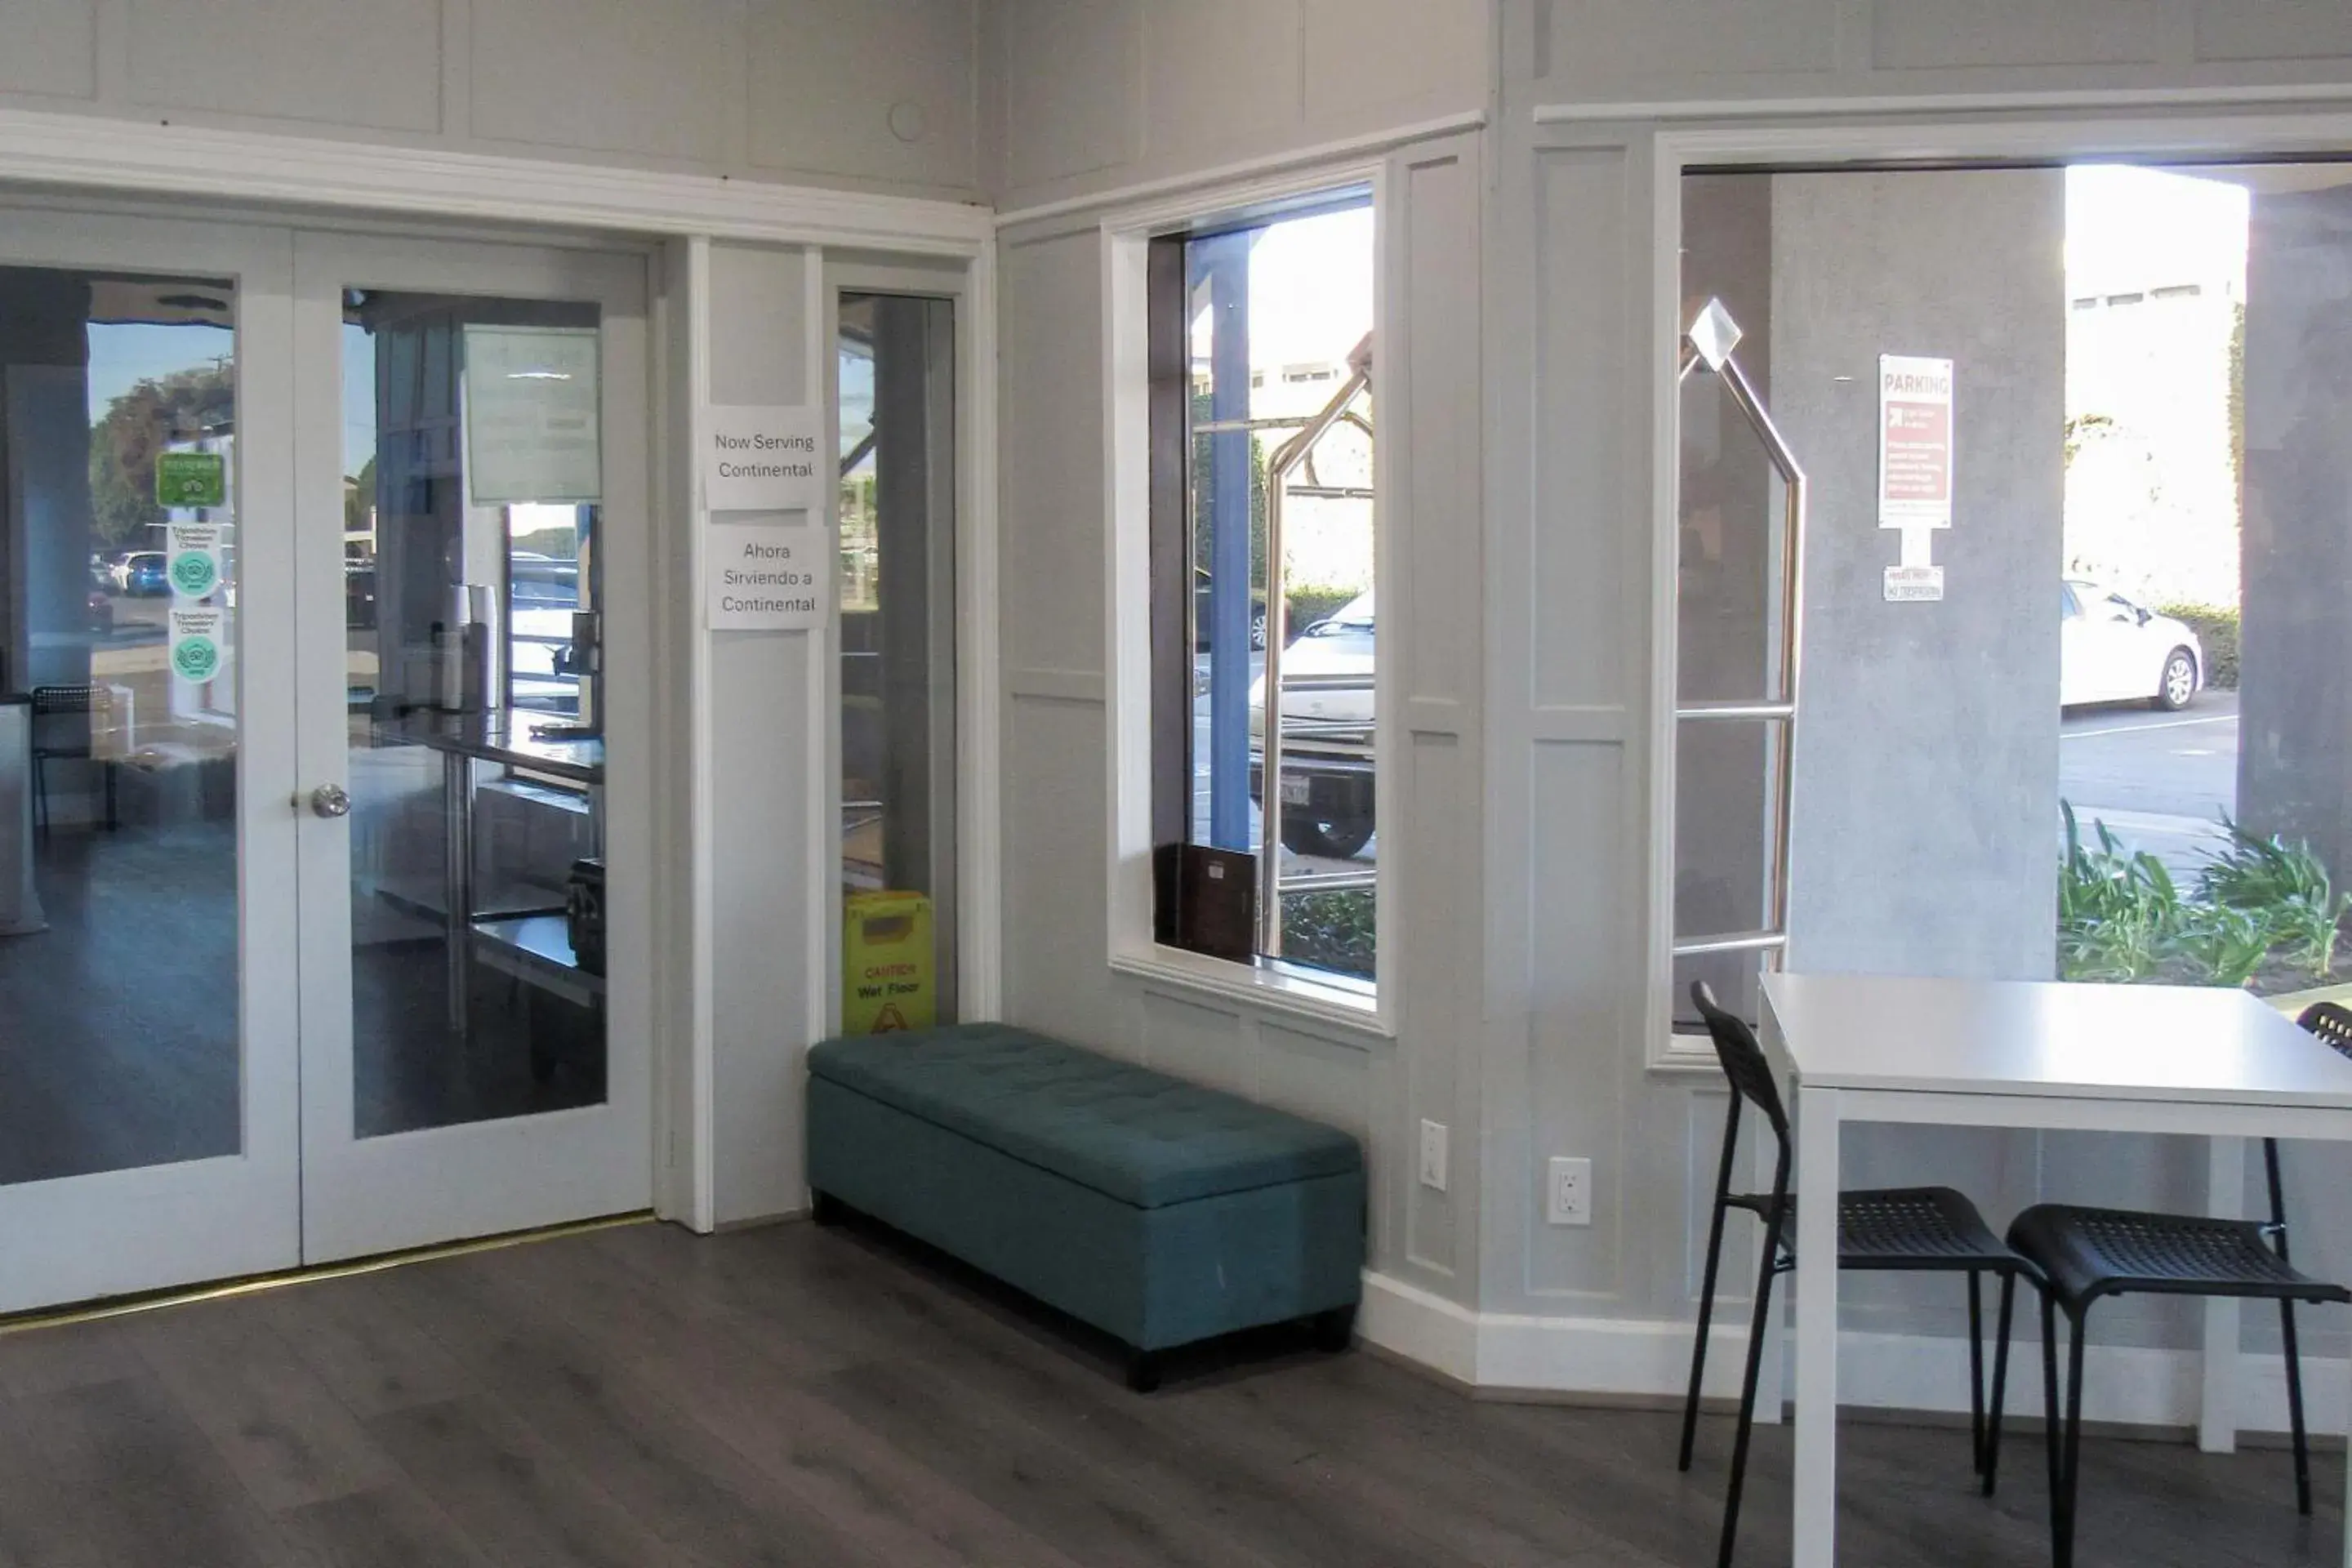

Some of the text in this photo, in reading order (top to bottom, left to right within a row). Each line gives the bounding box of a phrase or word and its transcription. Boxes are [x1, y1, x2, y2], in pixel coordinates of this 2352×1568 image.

[1885, 373, 1949, 395] PARKING
[715, 434, 815, 452] Now Serving
[719, 462, 813, 478] Continental
[744, 543, 791, 559] Ahora
[724, 569, 813, 586] Sirviendo a
[722, 596, 816, 612] Continental
[857, 982, 920, 1000] Wet Floor
